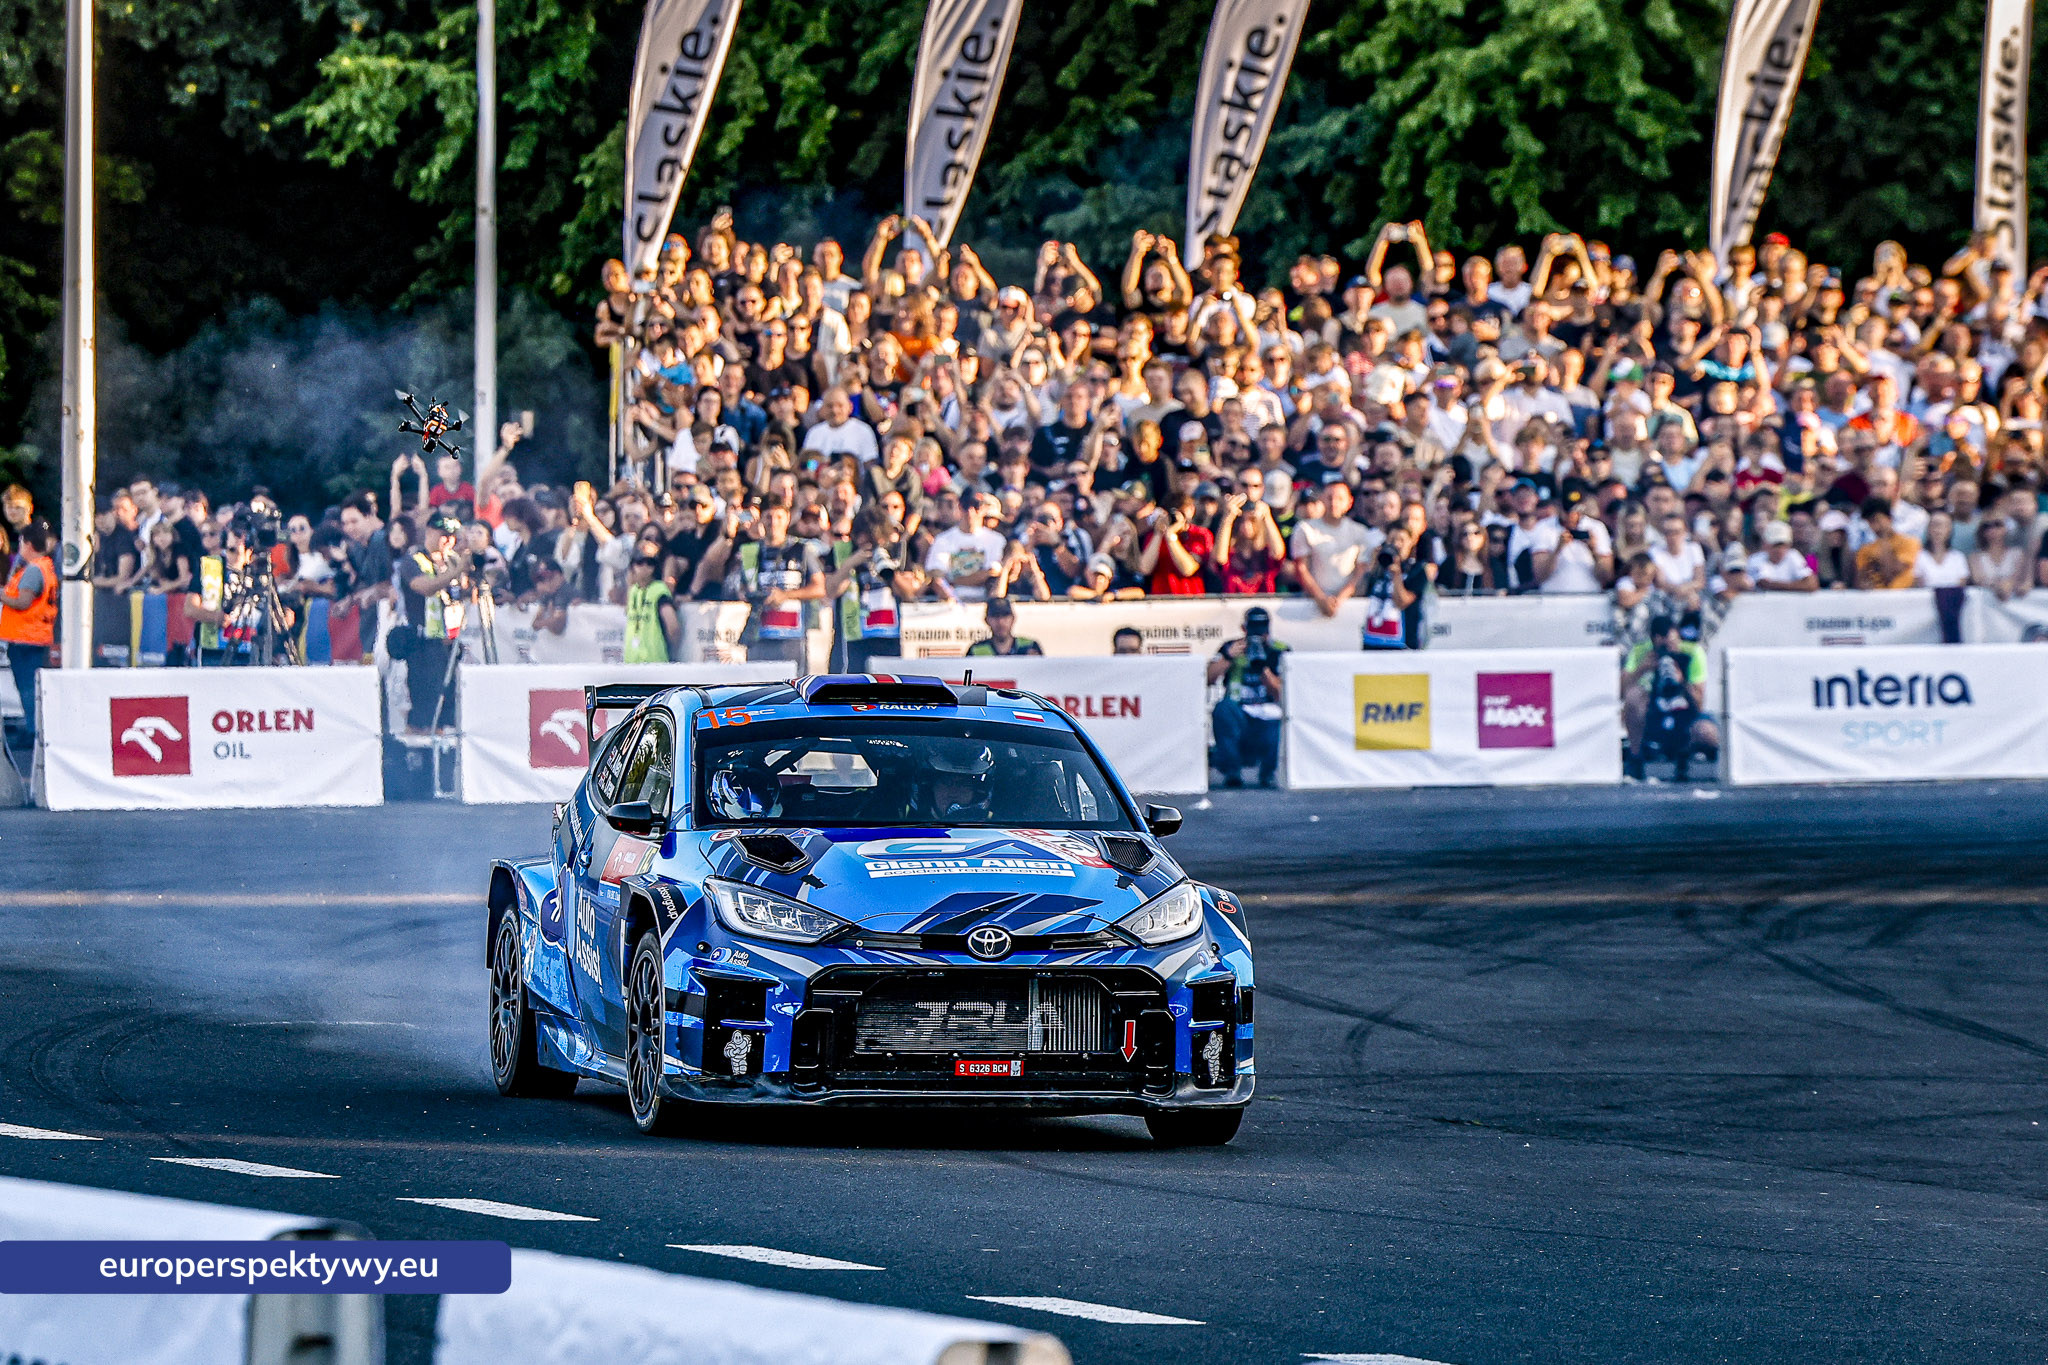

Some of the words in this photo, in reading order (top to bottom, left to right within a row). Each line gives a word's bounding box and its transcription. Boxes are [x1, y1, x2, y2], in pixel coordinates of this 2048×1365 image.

[212, 708, 315, 733] ORLEN
[700, 706, 752, 729] 15
[1363, 702, 1424, 724] RMF
[1841, 719, 1949, 748] SPORT
[213, 741, 251, 760] OIL
[864, 860, 969, 871] Glenn
[981, 859, 1073, 870] Allen
[884, 868, 955, 876] accident
[577, 886, 596, 940] Auto
[576, 925, 603, 987] Assist
[727, 956, 750, 967] Assist
[732, 949, 749, 960] Auto
[959, 1063, 966, 1073] S
[969, 1063, 990, 1073] 6326
